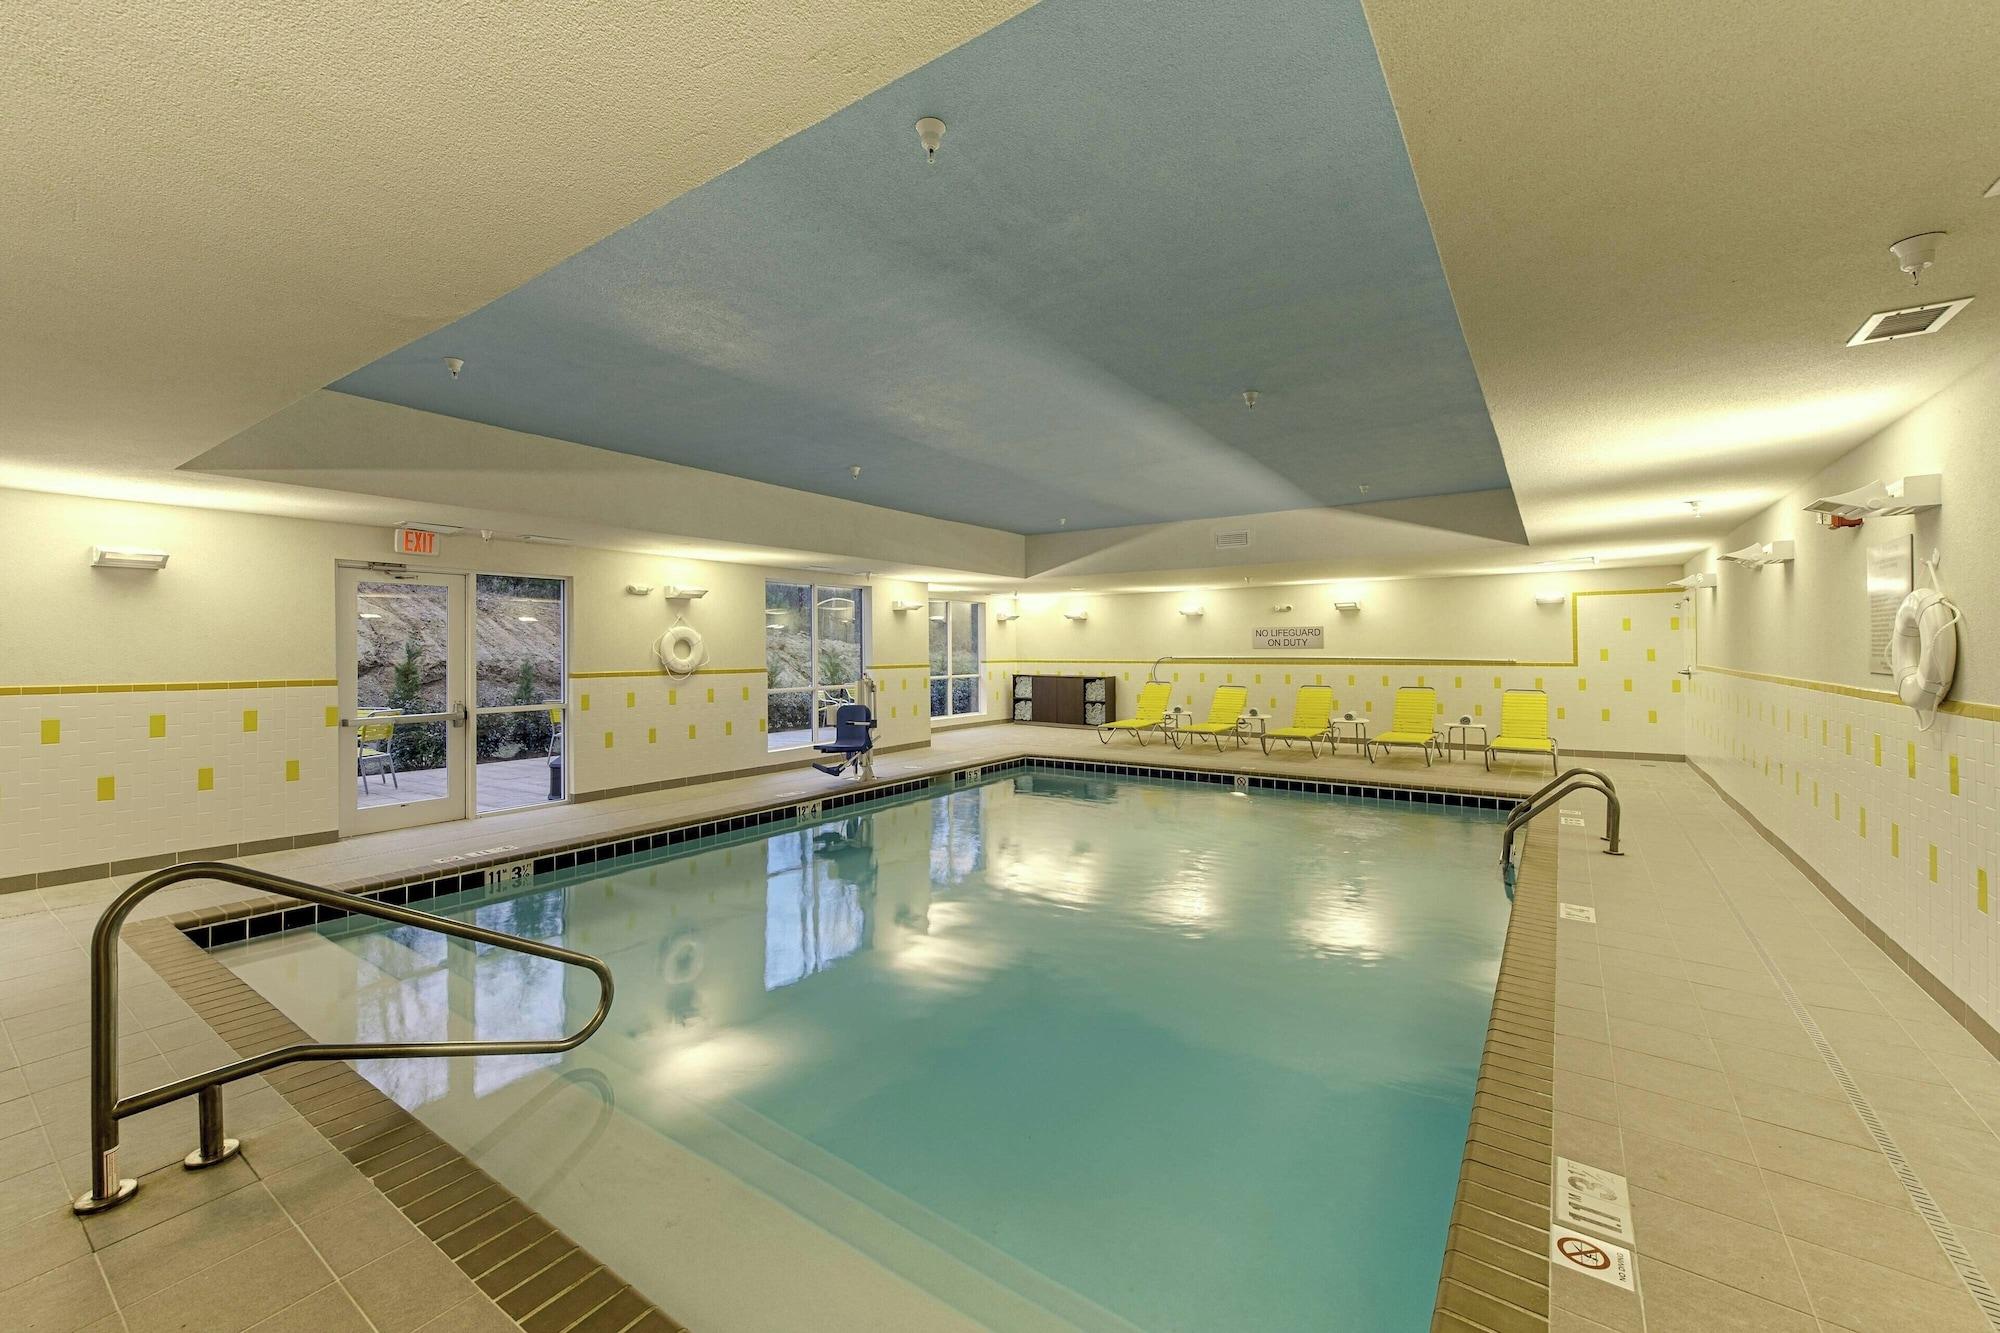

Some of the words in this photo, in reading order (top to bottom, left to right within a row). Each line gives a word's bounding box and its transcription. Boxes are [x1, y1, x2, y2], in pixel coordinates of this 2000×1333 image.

[404, 531, 434, 553] EXIT
[1255, 629, 1269, 637] NO
[1271, 628, 1321, 637] LIFEGUARD
[1267, 639, 1281, 647] ON
[1283, 638, 1308, 647] DUTY
[1616, 1252, 1626, 1273] DIVING
[1618, 1272, 1626, 1283] NO
